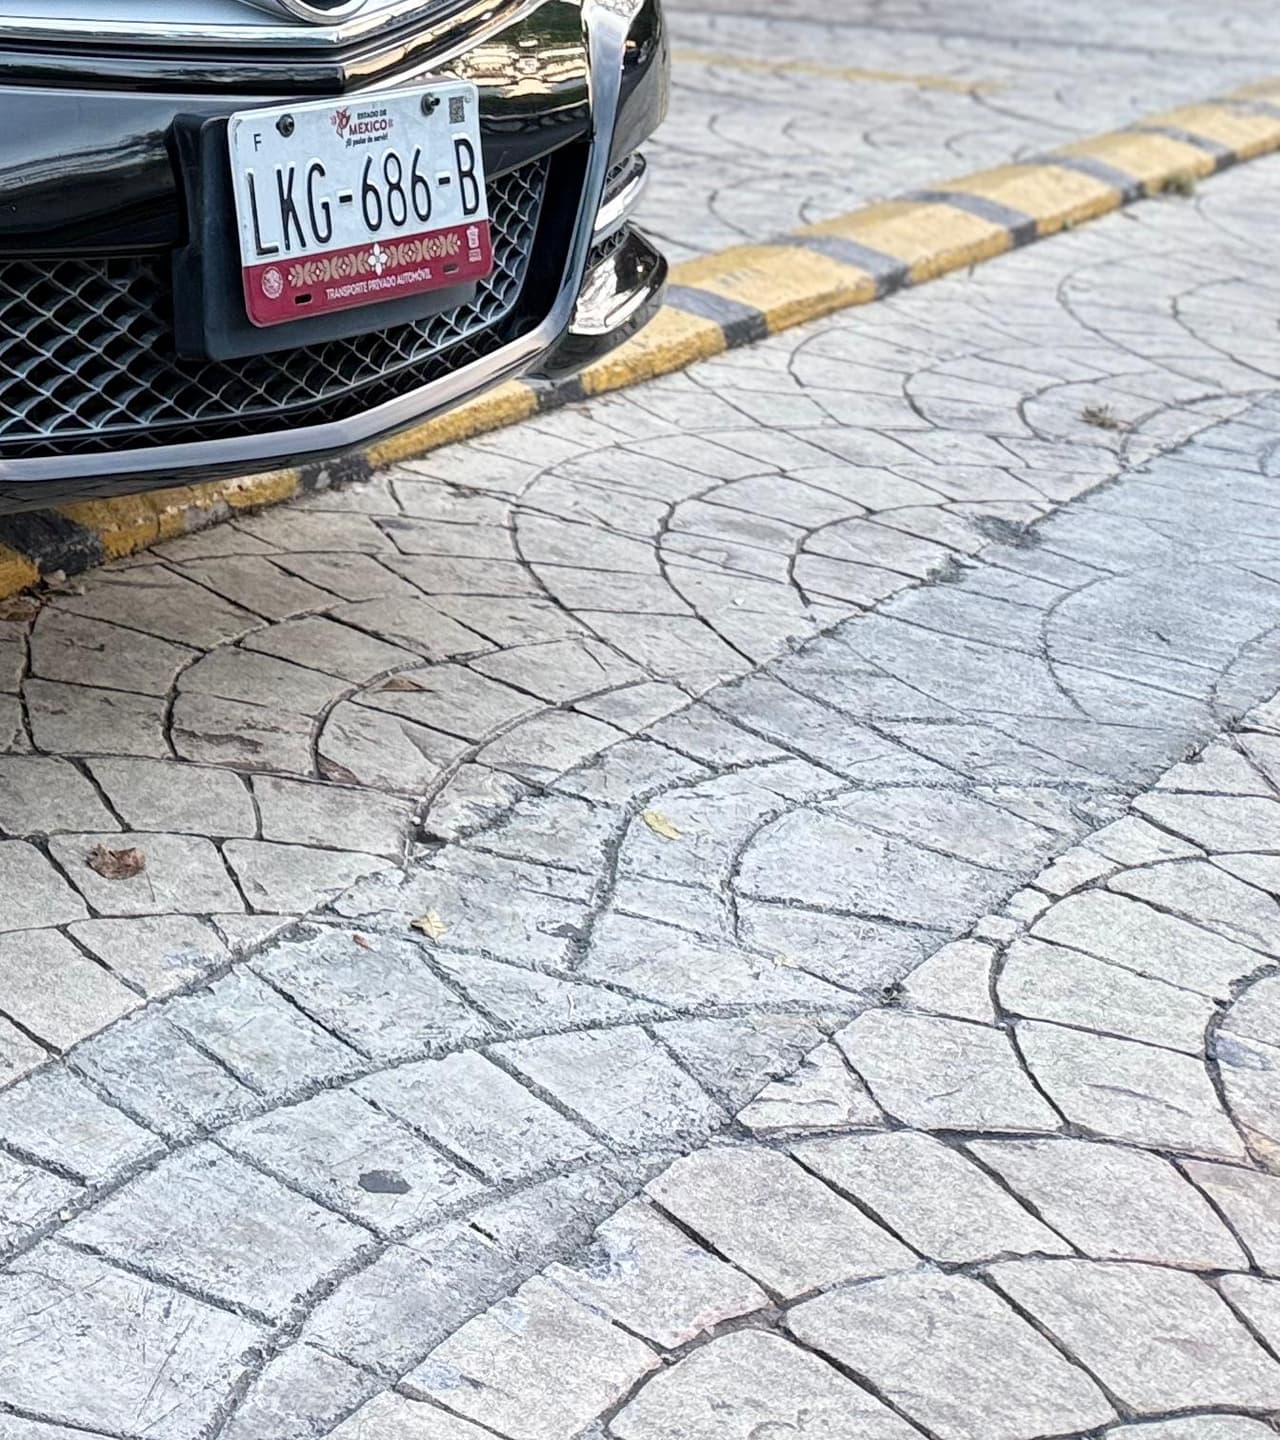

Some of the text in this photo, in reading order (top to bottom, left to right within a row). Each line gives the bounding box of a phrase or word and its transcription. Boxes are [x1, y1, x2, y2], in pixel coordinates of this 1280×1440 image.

[357, 108, 387, 120] ESTADO DE
[253, 132, 262, 152] F
[246, 137, 481, 257] LKG-686-B
[325, 281, 369, 300] TRANSPORTE
[368, 275, 397, 291] PRIVADO
